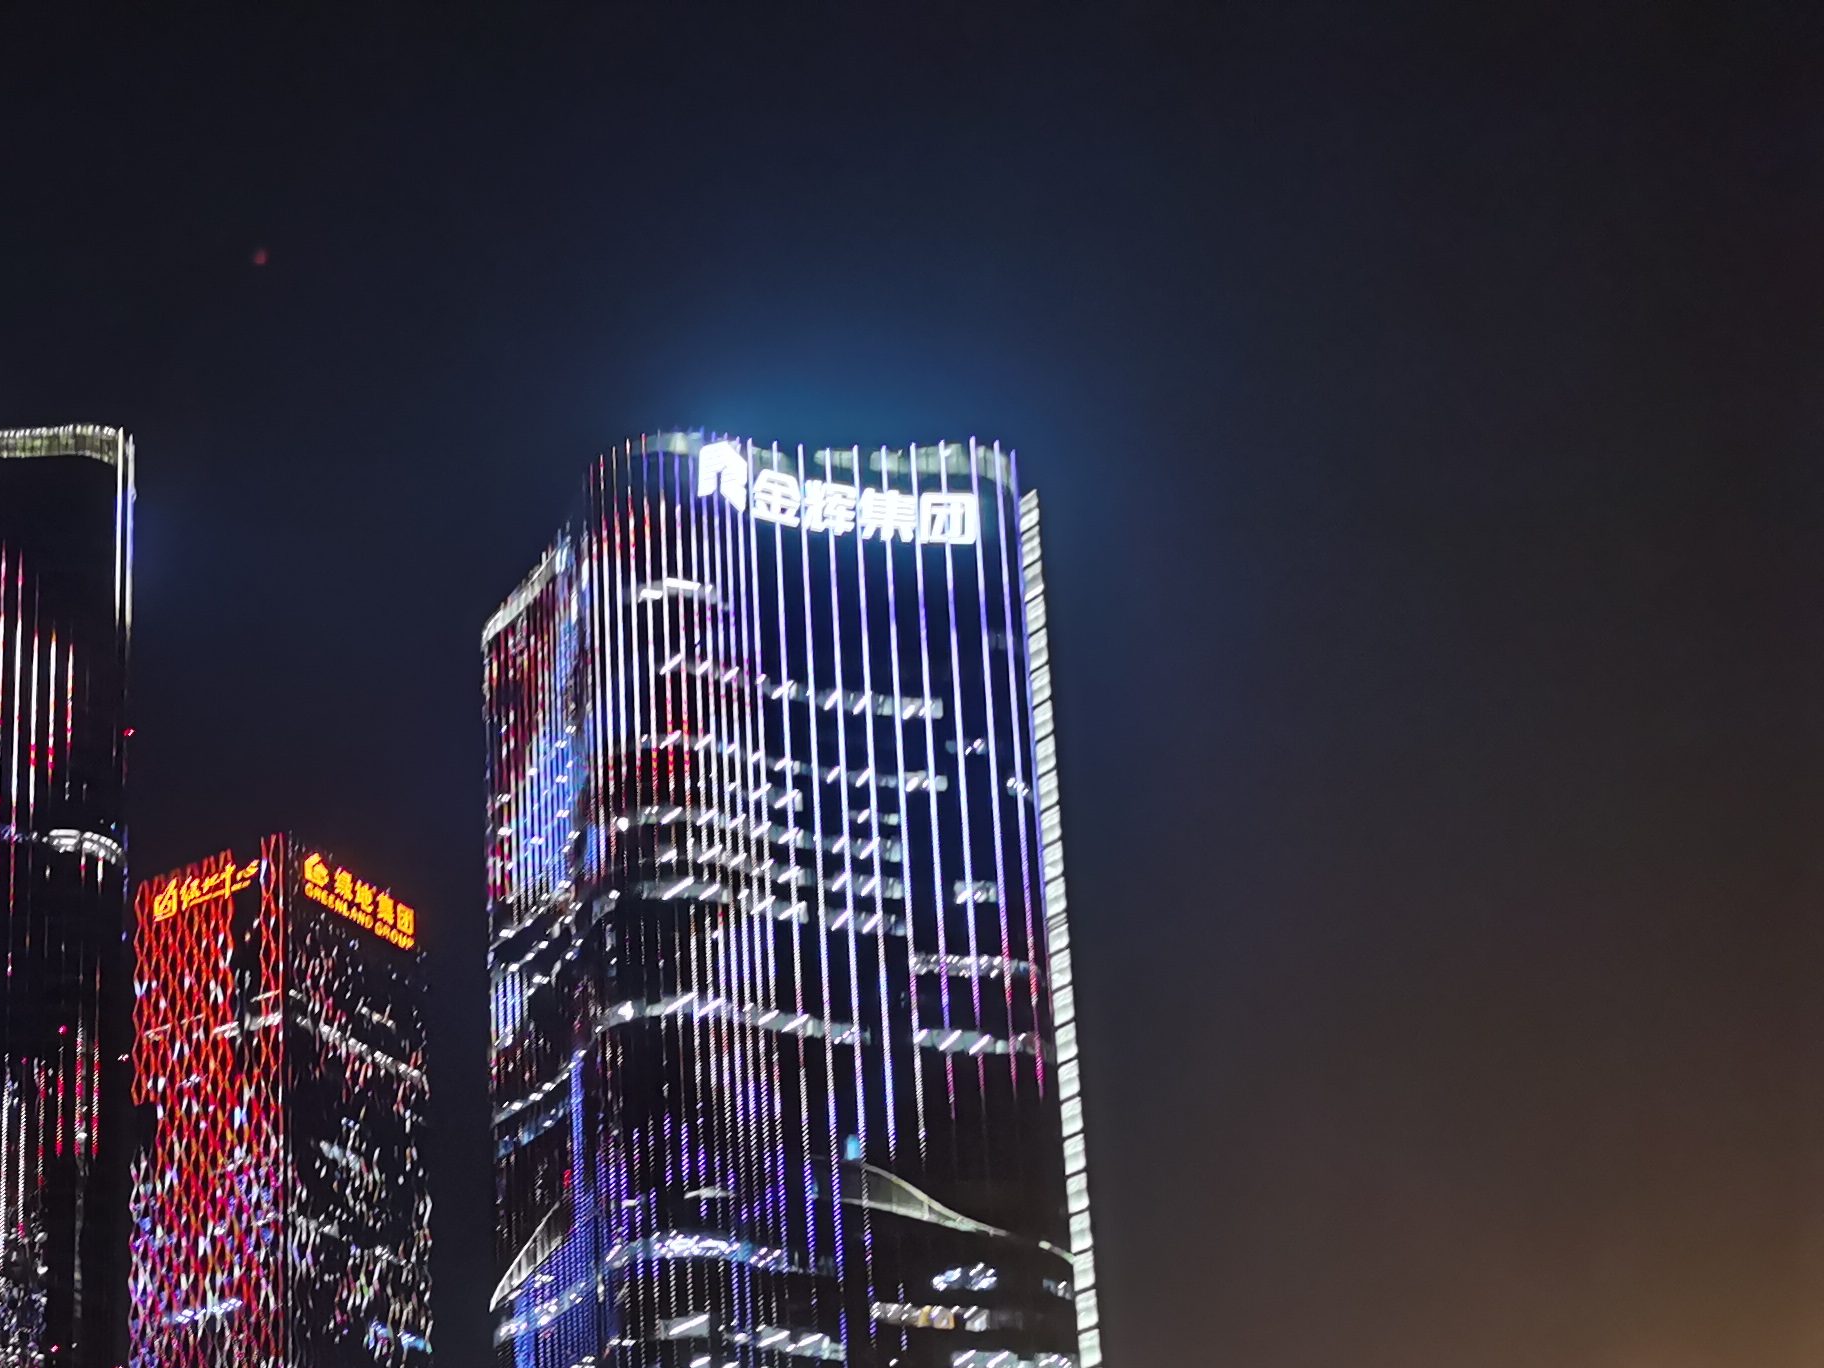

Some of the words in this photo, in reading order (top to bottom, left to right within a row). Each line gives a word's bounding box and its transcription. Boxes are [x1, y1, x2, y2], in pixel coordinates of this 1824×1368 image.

[751, 468, 978, 545] 金辉集团
[304, 881, 374, 930] GREENLAND
[374, 920, 416, 951] GROUP
